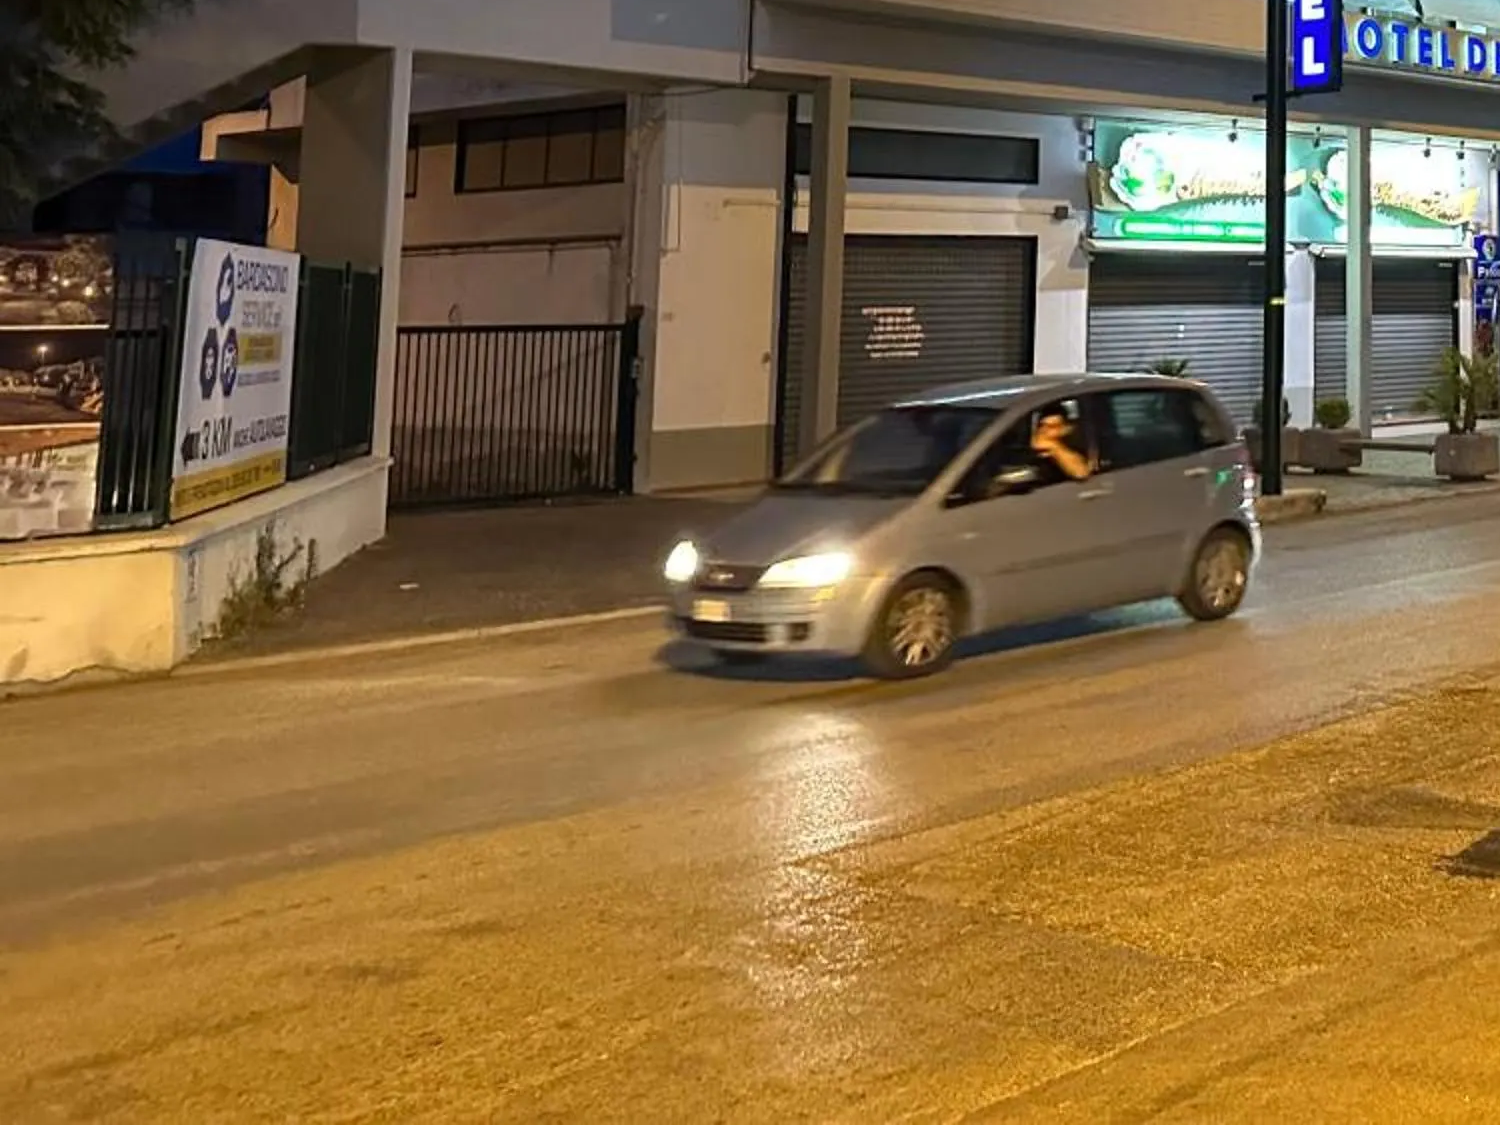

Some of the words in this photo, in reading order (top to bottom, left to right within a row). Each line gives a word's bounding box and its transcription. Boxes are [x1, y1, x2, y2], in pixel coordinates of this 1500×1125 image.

[1343, 17, 1456, 72] OTEL
[201, 419, 210, 460] 3
[212, 416, 232, 459] KM
